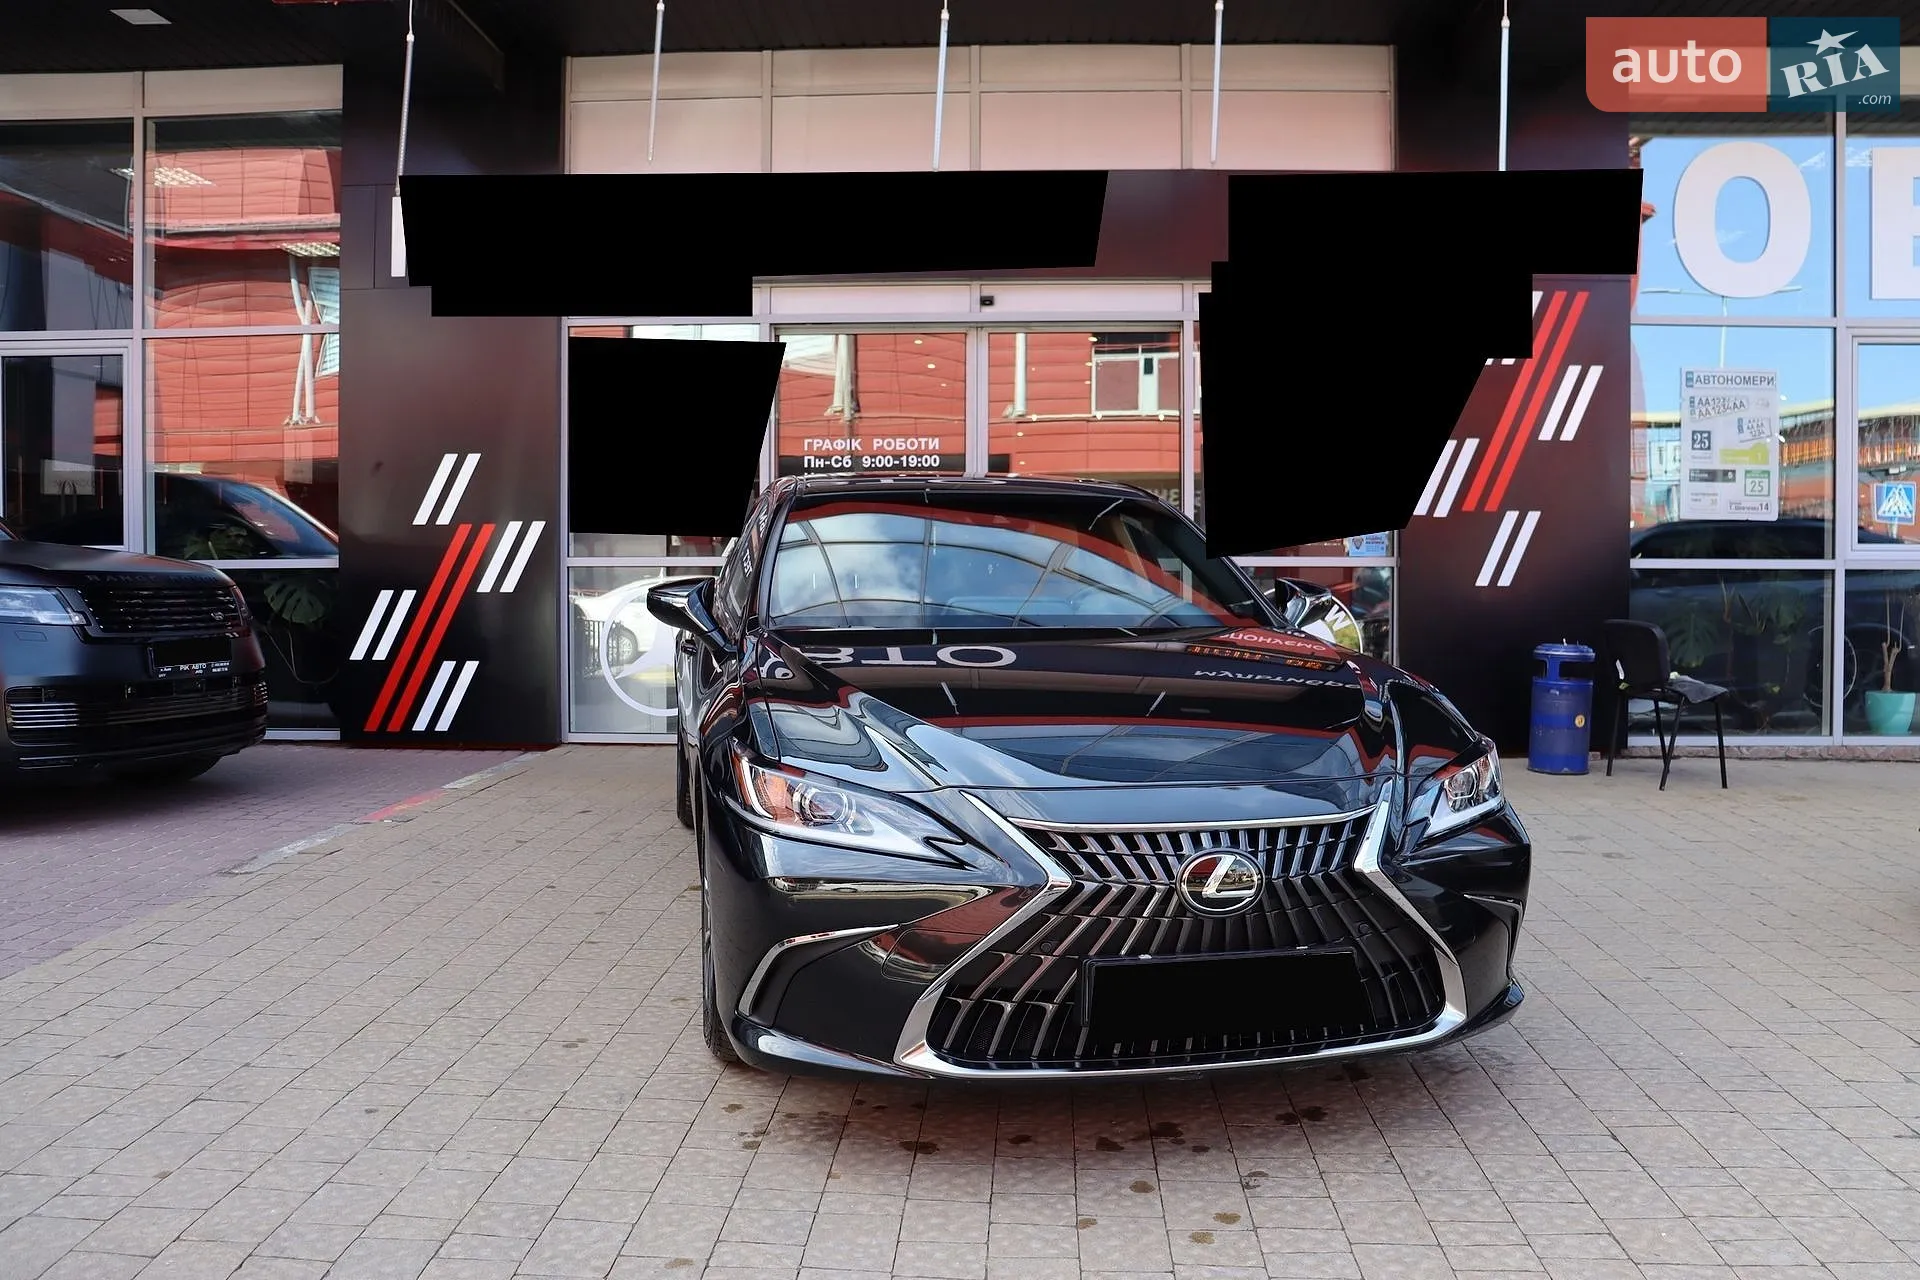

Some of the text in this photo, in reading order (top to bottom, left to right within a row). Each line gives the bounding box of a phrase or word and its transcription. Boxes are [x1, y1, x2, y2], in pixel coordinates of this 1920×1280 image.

[1695, 375, 1775, 386] АВТОНОМЕРИ
[804, 438, 940, 452] ГРАФІК РОБОТИ
[1693, 432, 1709, 450] 25
[804, 454, 940, 469] Пн-Сб 9:00-19:00
[1750, 480, 1764, 493] 25
